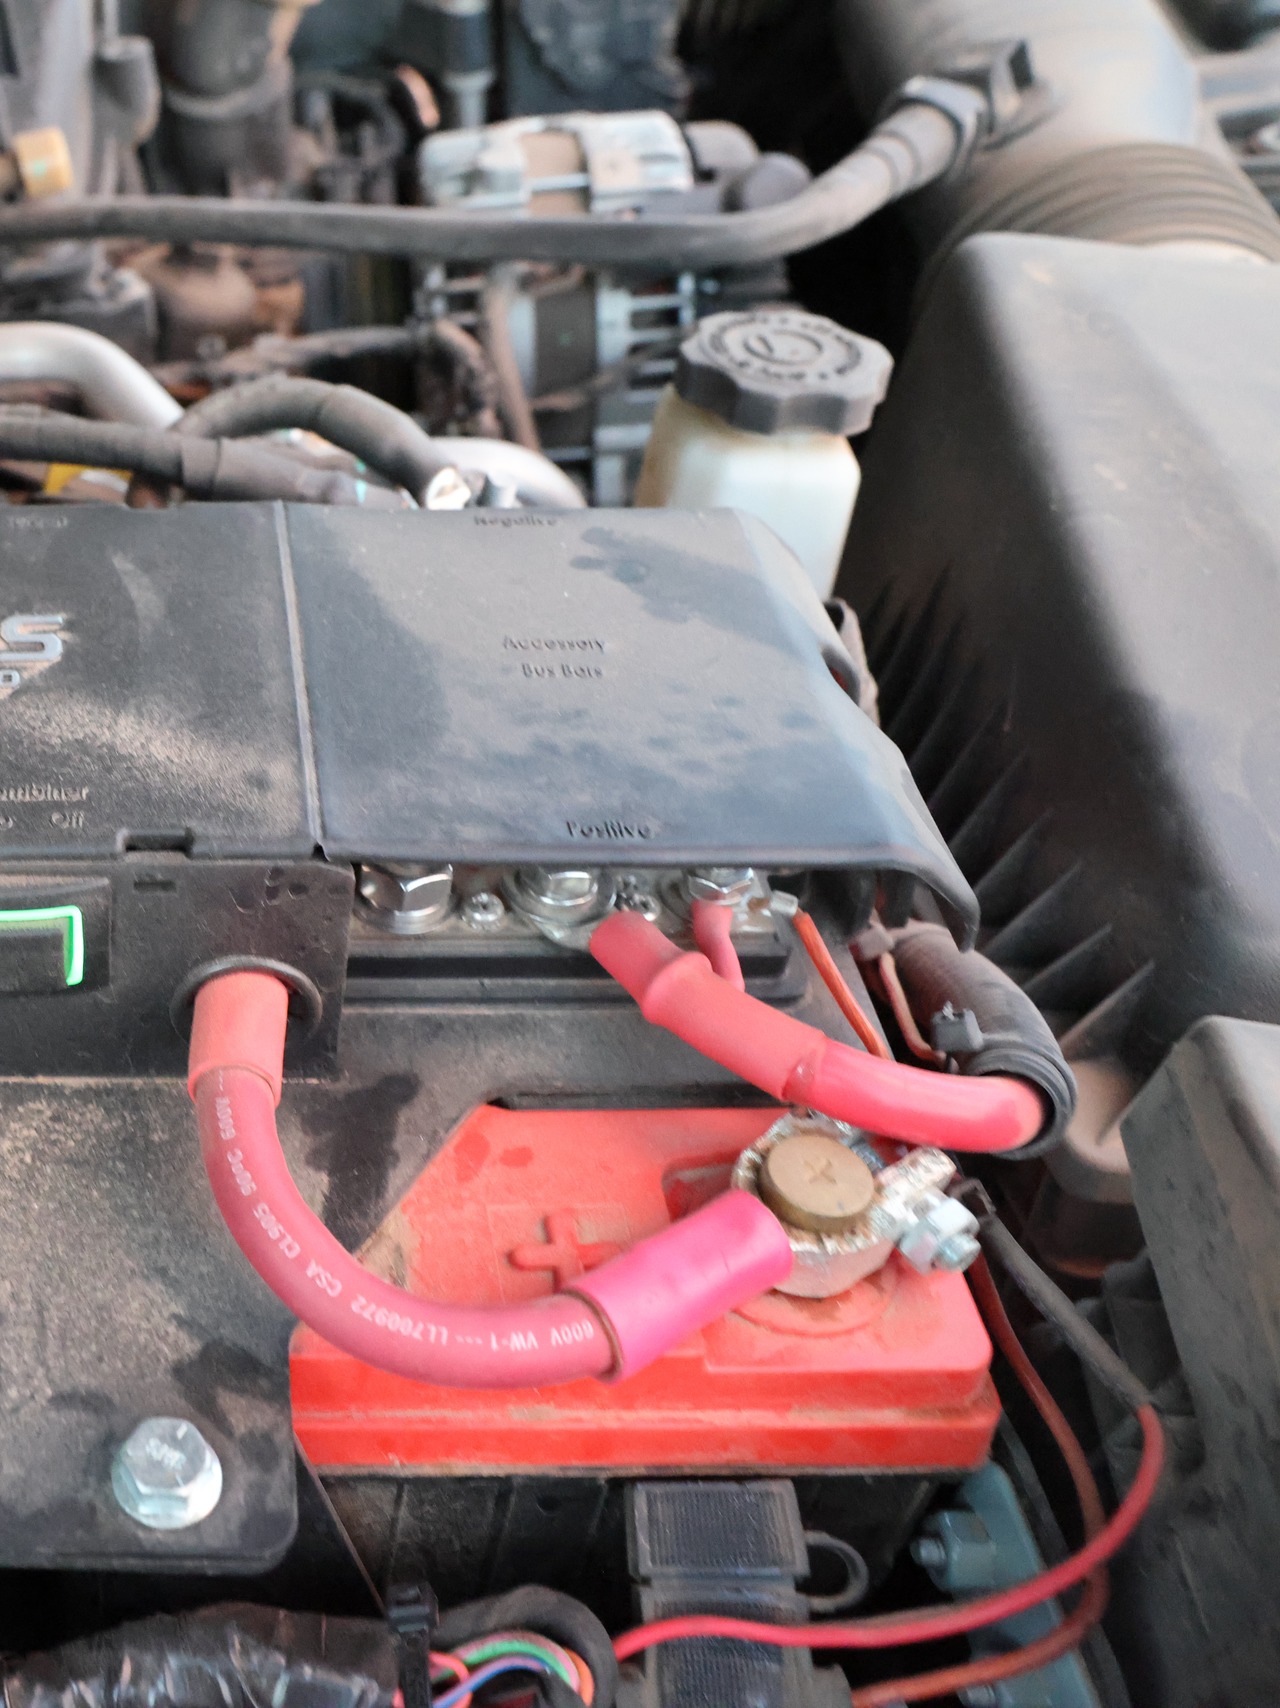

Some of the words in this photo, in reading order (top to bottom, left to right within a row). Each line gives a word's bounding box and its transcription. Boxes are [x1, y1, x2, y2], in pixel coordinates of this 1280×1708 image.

[503, 635, 605, 653] Accessory
[521, 663, 553, 678] Bus
[305, 1259, 343, 1297] CSA
[351, 1293, 449, 1347] LL700972
[550, 1318, 595, 1347] 600V
[489, 1329, 539, 1352] VW-1
